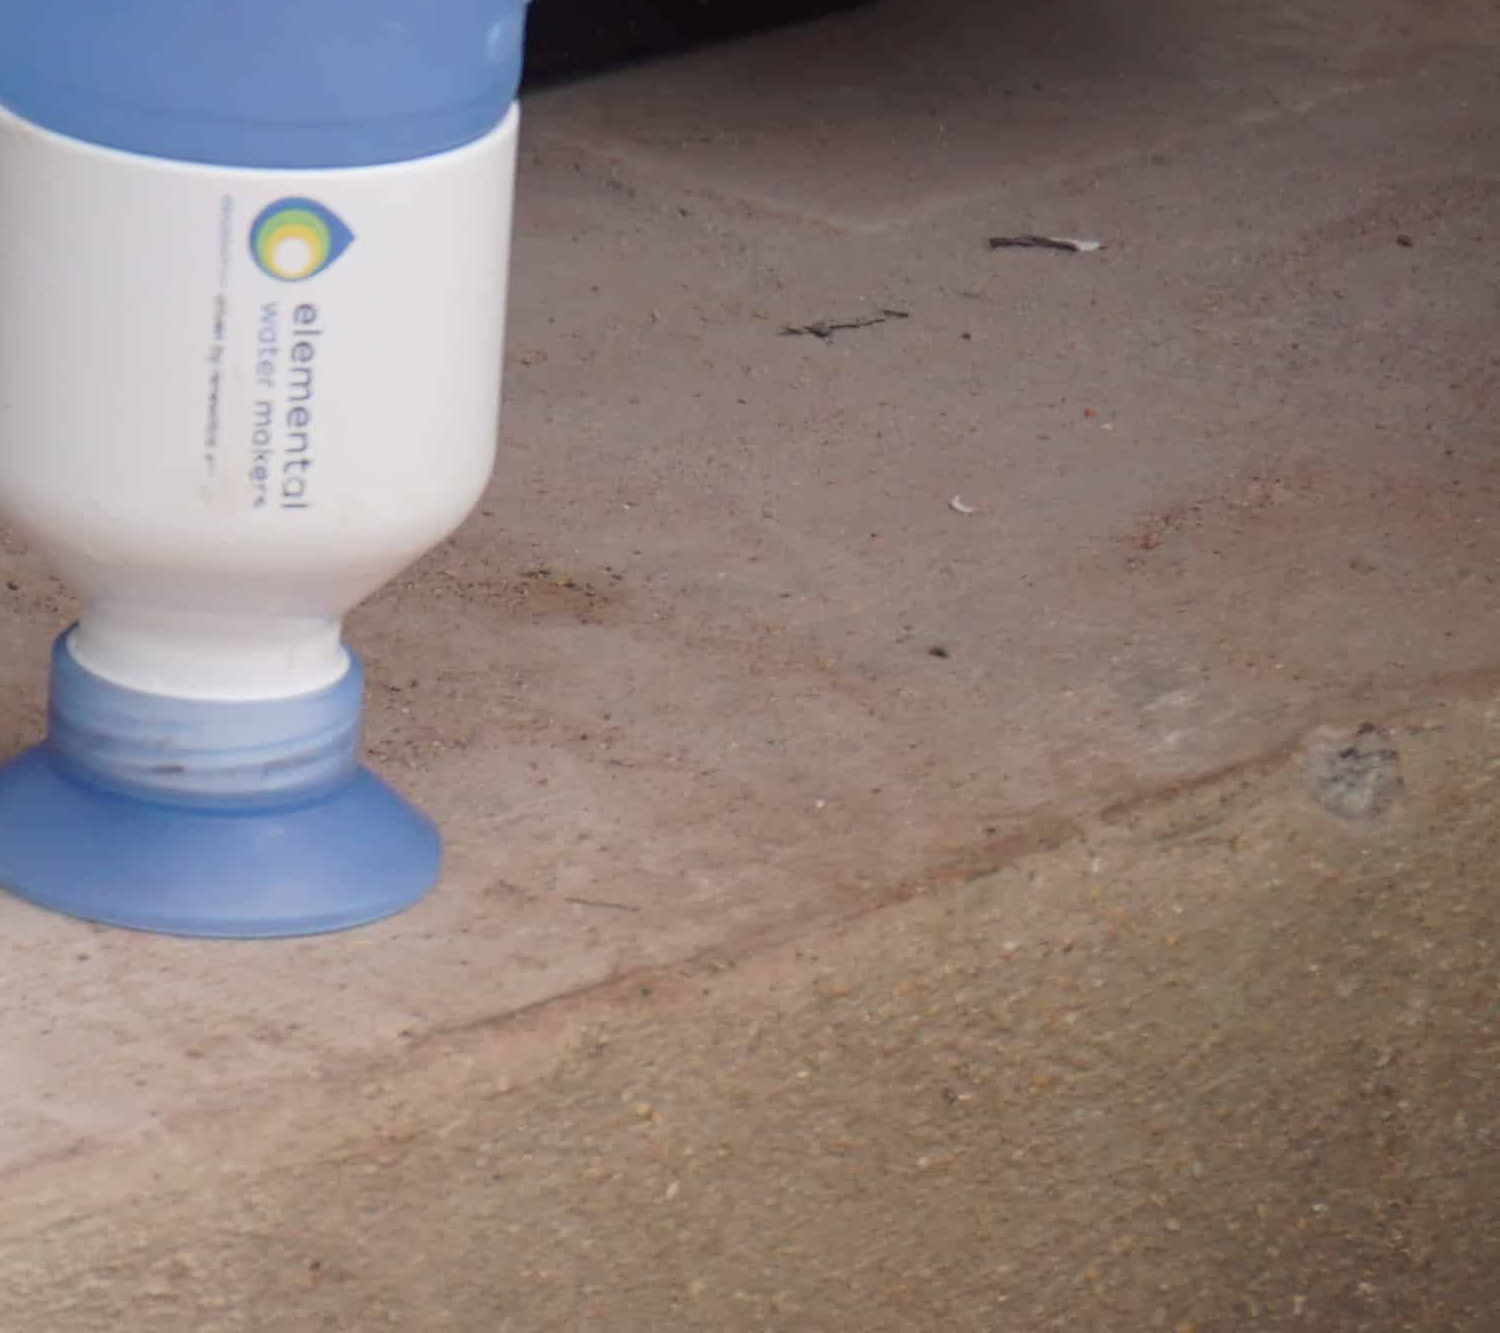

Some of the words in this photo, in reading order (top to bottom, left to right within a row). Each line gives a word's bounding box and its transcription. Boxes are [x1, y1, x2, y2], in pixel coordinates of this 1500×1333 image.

[254, 300, 280, 389] water
[249, 400, 273, 508] makers
[279, 302, 324, 510] elemental
